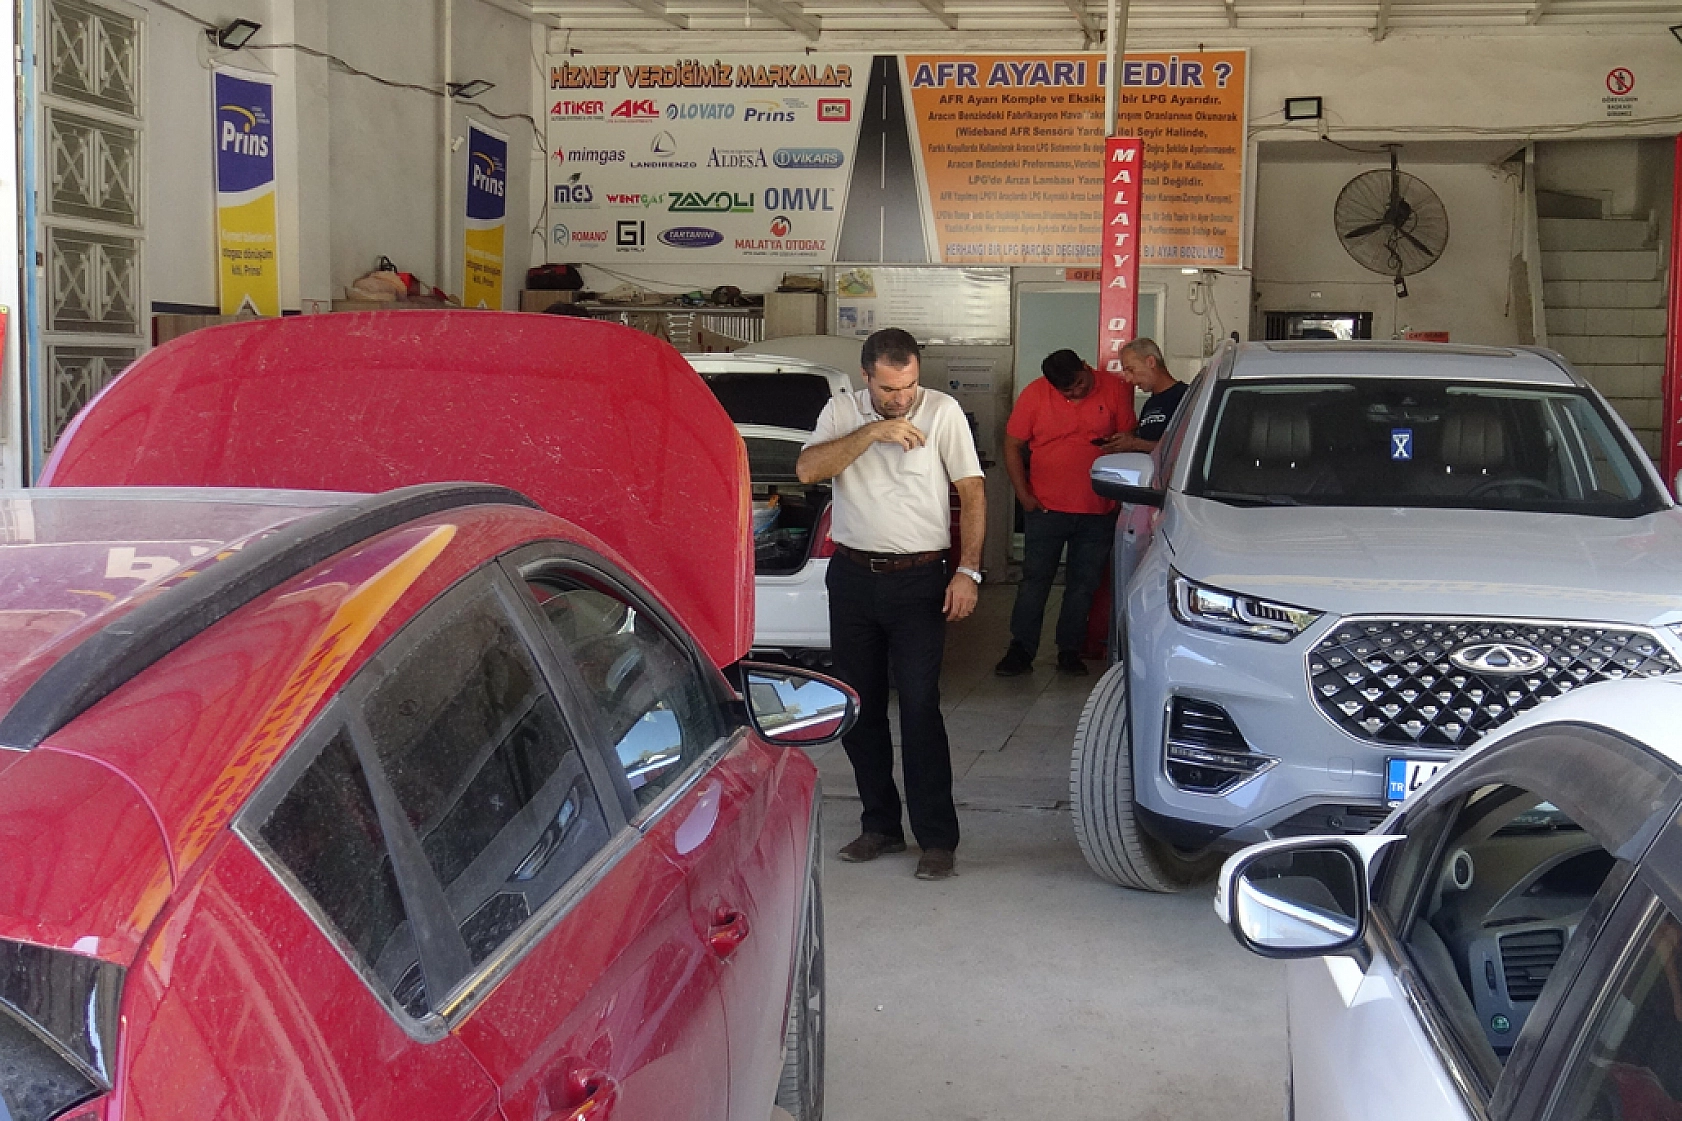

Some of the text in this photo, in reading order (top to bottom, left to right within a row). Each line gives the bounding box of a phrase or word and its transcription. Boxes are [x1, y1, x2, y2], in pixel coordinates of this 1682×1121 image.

[551, 58, 852, 88] HİZMET VERDİĞİMİZ MARKALAR
[912, 62, 979, 88] AFR
[987, 61, 1086, 87] AYARI
[610, 99, 660, 119] AKL
[939, 95, 963, 104] AFR
[1001, 95, 1047, 106] Komple
[1122, 94, 1139, 104] bir
[1142, 95, 1167, 104] LPG
[679, 102, 735, 120] LOVATO
[743, 107, 796, 122] Prins
[221, 120, 269, 158] Prins
[1010, 127, 1031, 137] AFR
[568, 147, 627, 165] mimgas
[473, 163, 504, 197] Prins
[764, 187, 834, 211] OMVL
[734, 239, 827, 251] MALATYA OTOGAZ
[1390, 782, 1405, 792] TR
